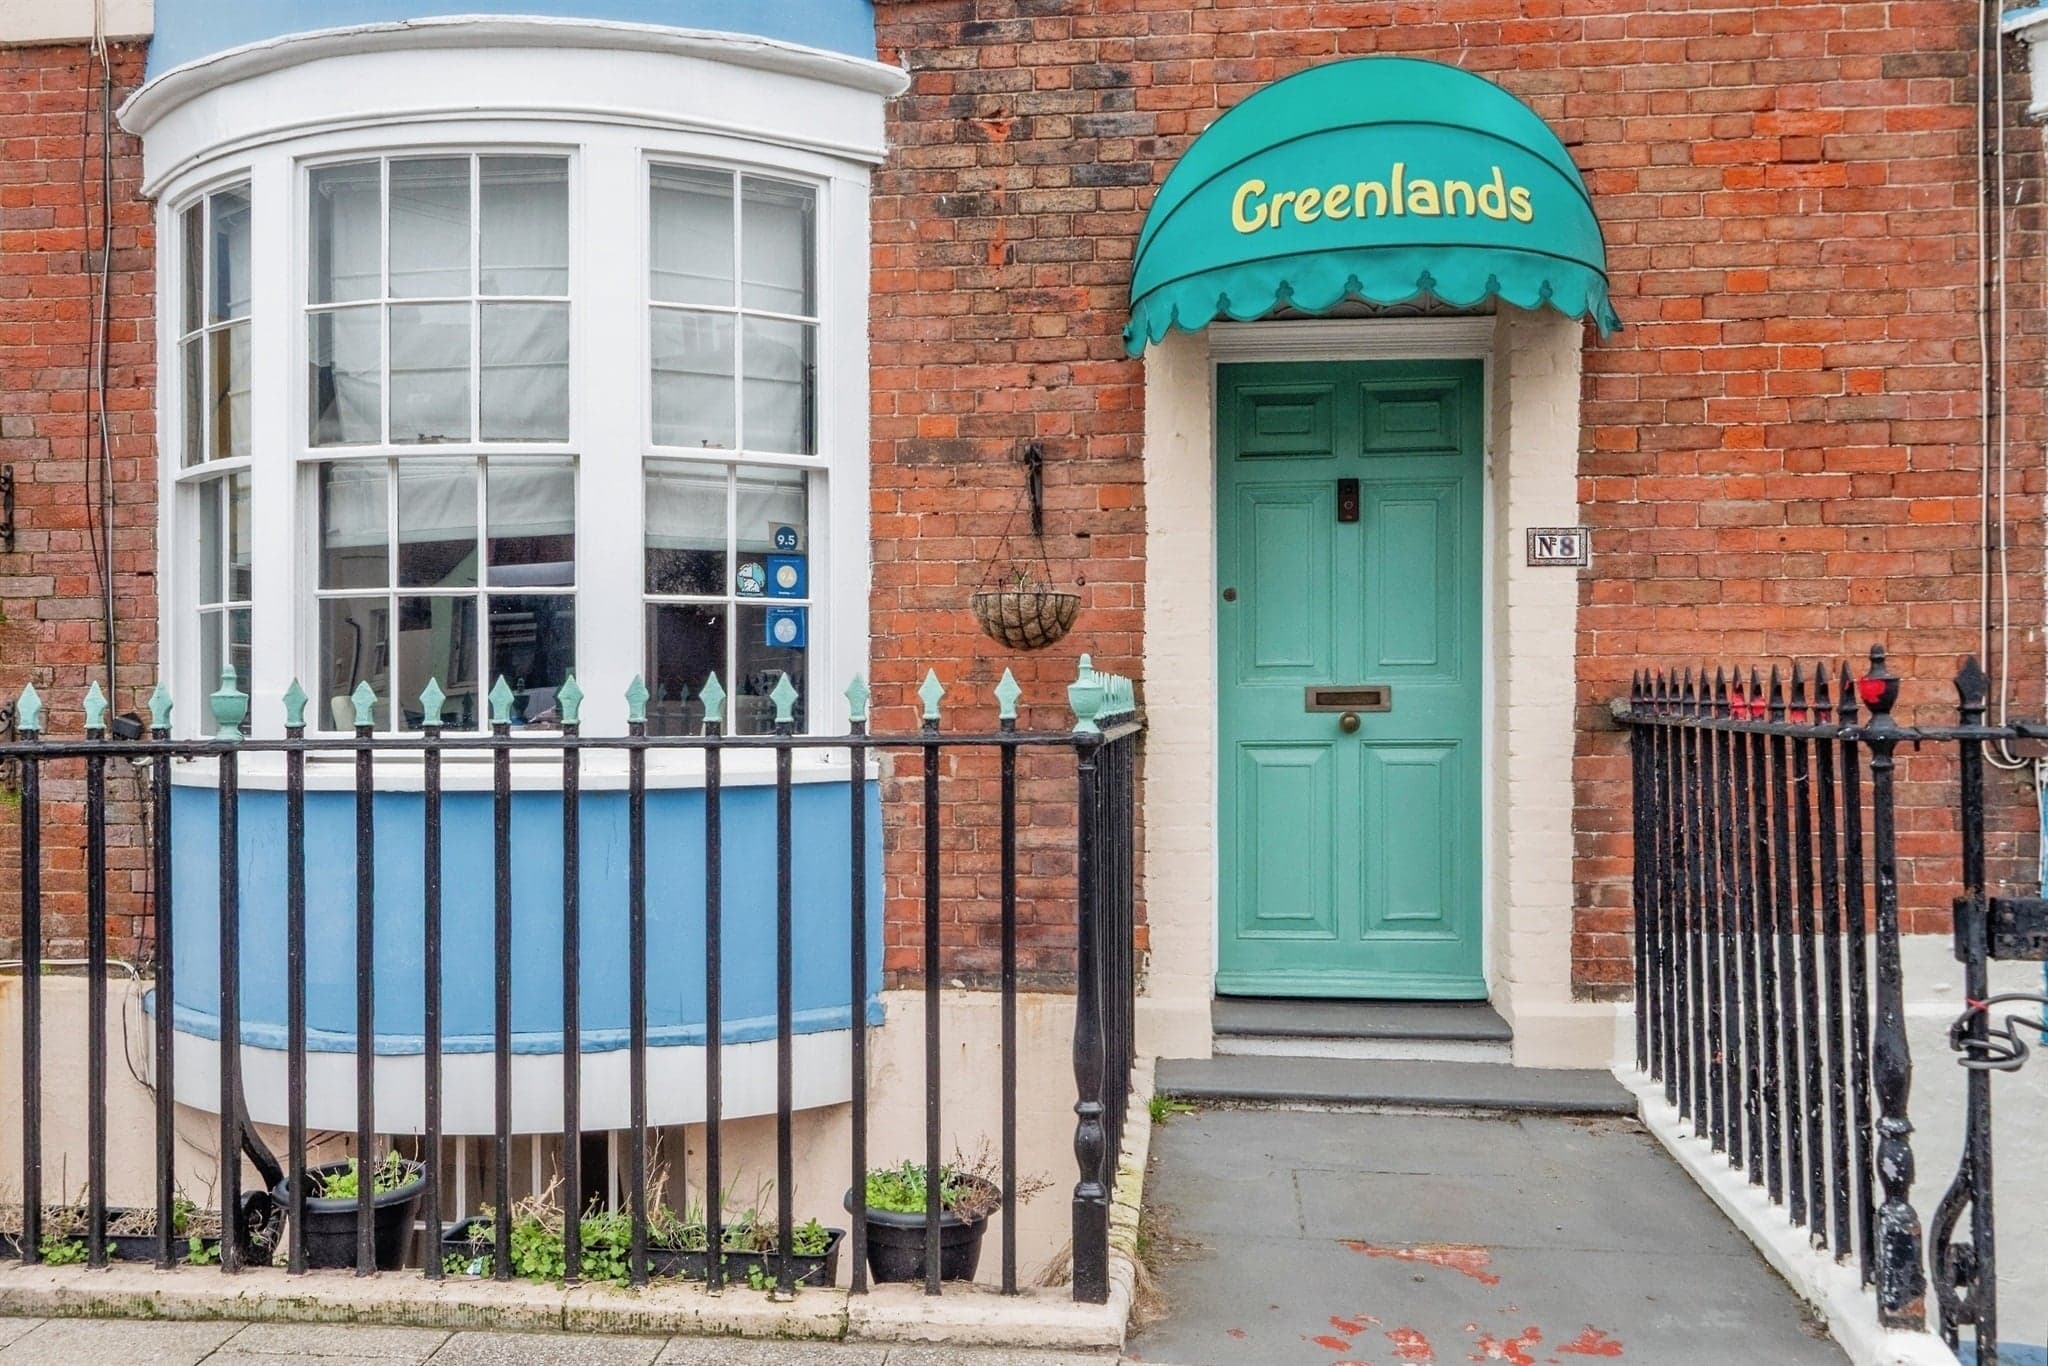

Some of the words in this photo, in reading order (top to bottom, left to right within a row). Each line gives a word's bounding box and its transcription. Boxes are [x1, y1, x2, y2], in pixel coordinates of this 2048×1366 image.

[1231, 162, 1534, 234] Greenlands
[777, 534, 795, 545] 9.5
[1560, 536, 1574, 556] 8
